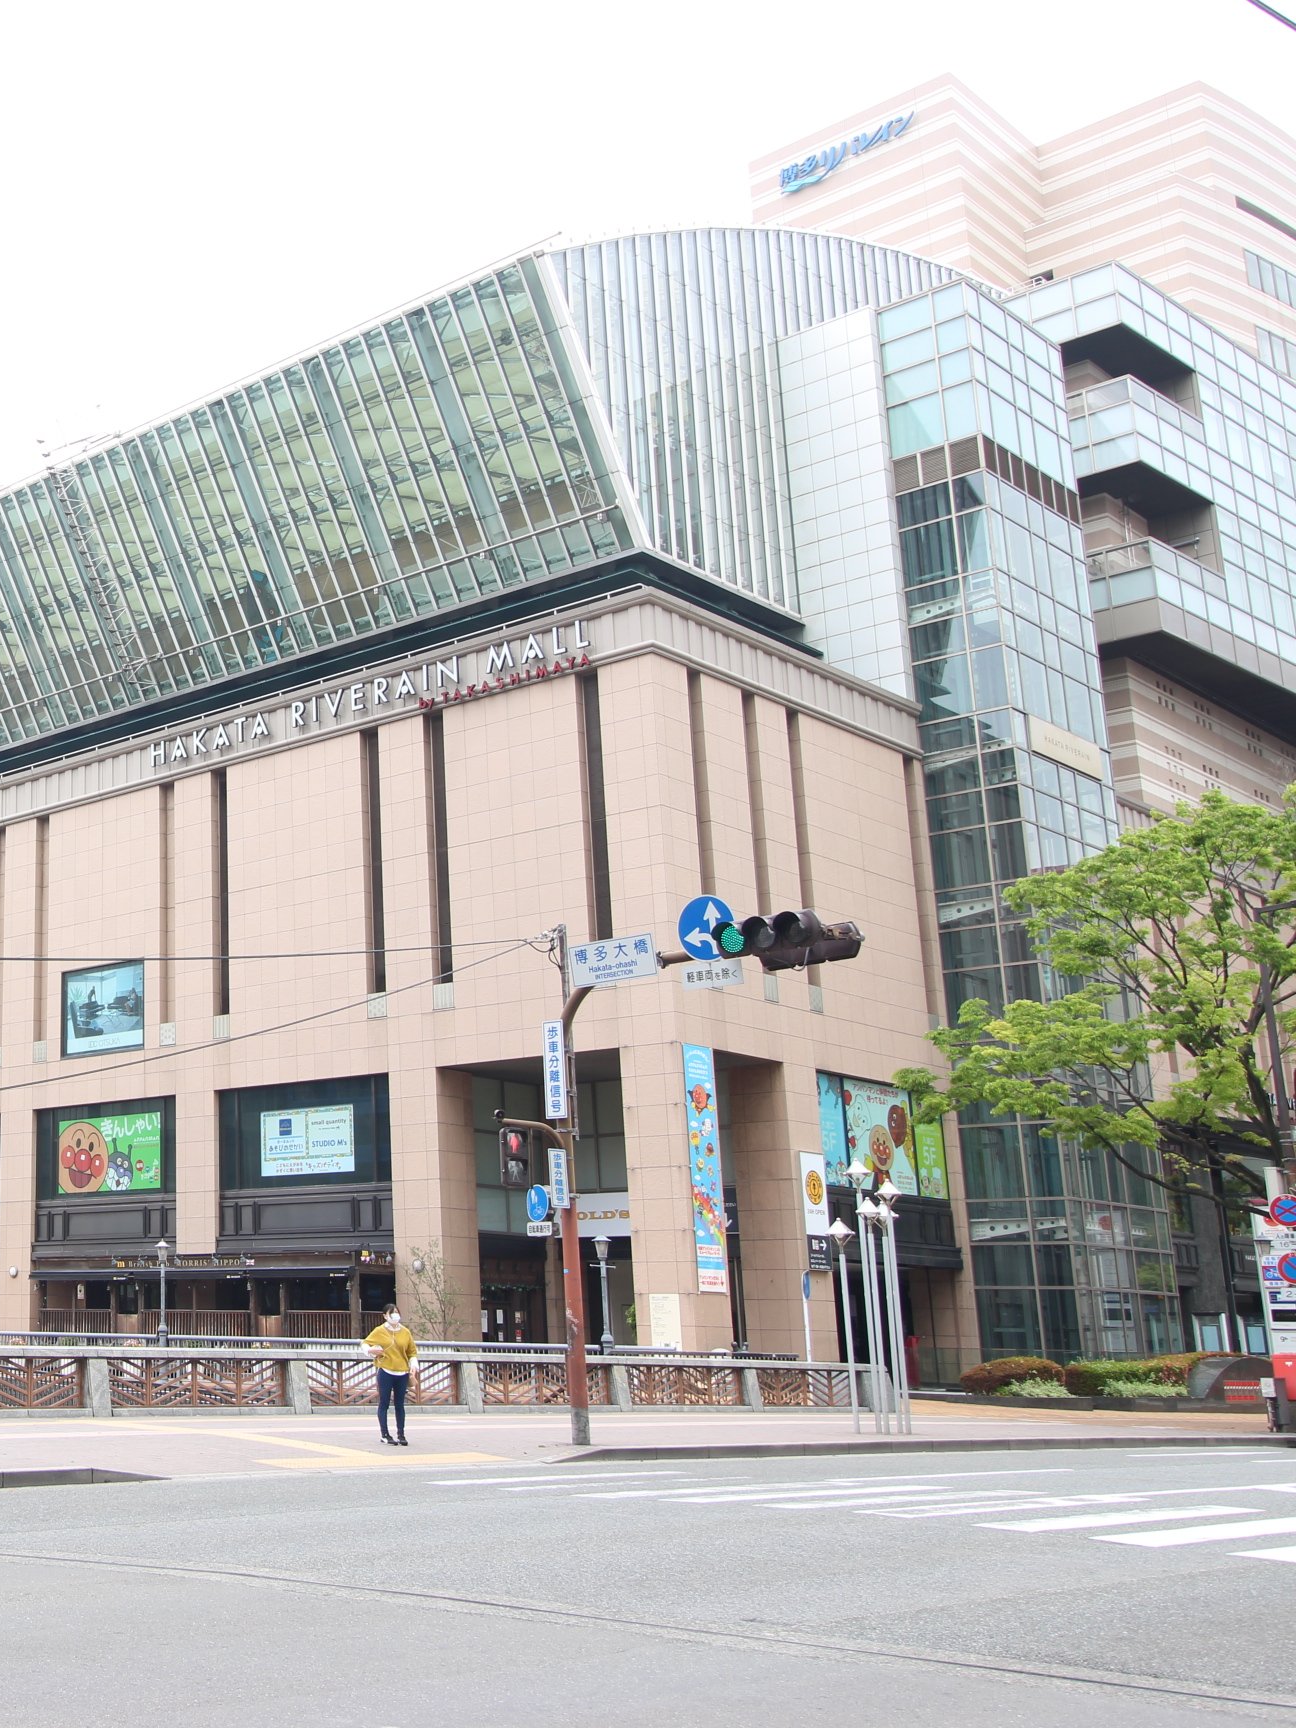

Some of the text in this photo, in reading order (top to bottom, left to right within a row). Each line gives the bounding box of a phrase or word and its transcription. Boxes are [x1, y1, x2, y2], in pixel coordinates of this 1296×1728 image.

[779, 110, 914, 188] 博多リバレイン
[418, 653, 591, 710] by TAKASHIMAYA
[150, 620, 591, 767] HAKATA RIVERAIN MALL
[574, 938, 649, 966] 博多大橋
[588, 960, 638, 974] Hakata-ohashi
[594, 969, 634, 980] INTERSECTION
[686, 967, 738, 984] 軽車両を除く
[547, 1026, 562, 1113] 歩車分離信号
[325, 1118, 347, 1126] quantity
[311, 1139, 336, 1147] STUDIO
[922, 1146, 937, 1166] 5F
[553, 1152, 565, 1204] 歩車分離信号
[561, 1209, 630, 1221] OLD'S
[156, 1260, 170, 1268] Pb
[176, 1259, 210, 1268] ORRIS'
